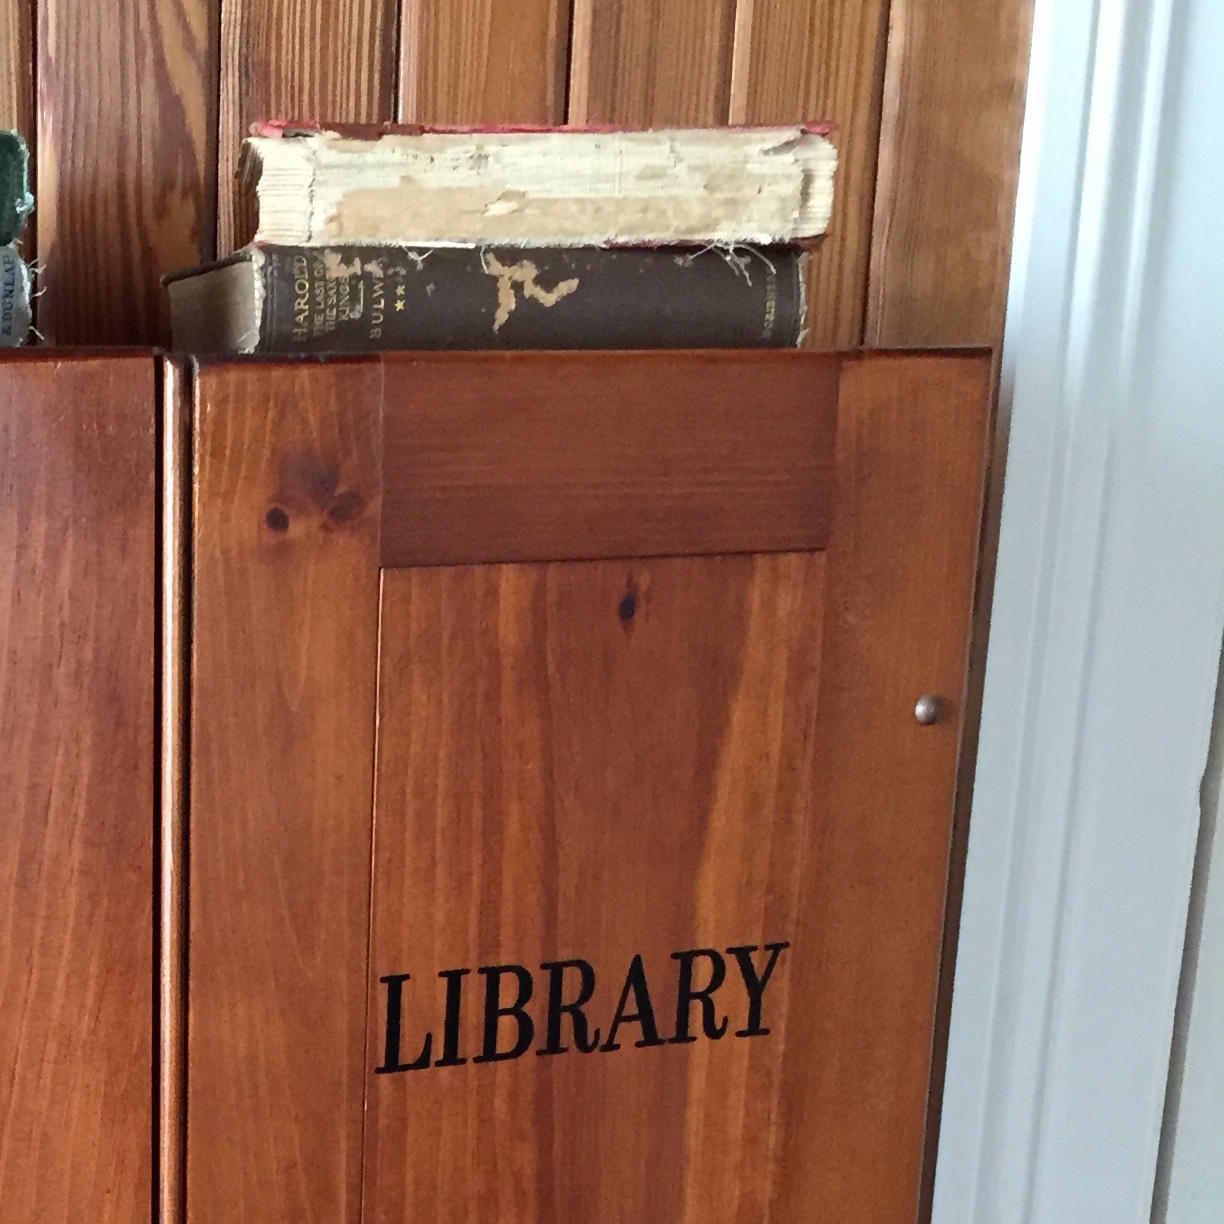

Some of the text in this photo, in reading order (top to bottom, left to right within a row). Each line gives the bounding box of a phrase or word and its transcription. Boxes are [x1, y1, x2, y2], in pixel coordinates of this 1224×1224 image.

[292, 255, 309, 342] HAROLD
[313, 280, 325, 309] LAST
[375, 942, 790, 1074] LIBRARY
